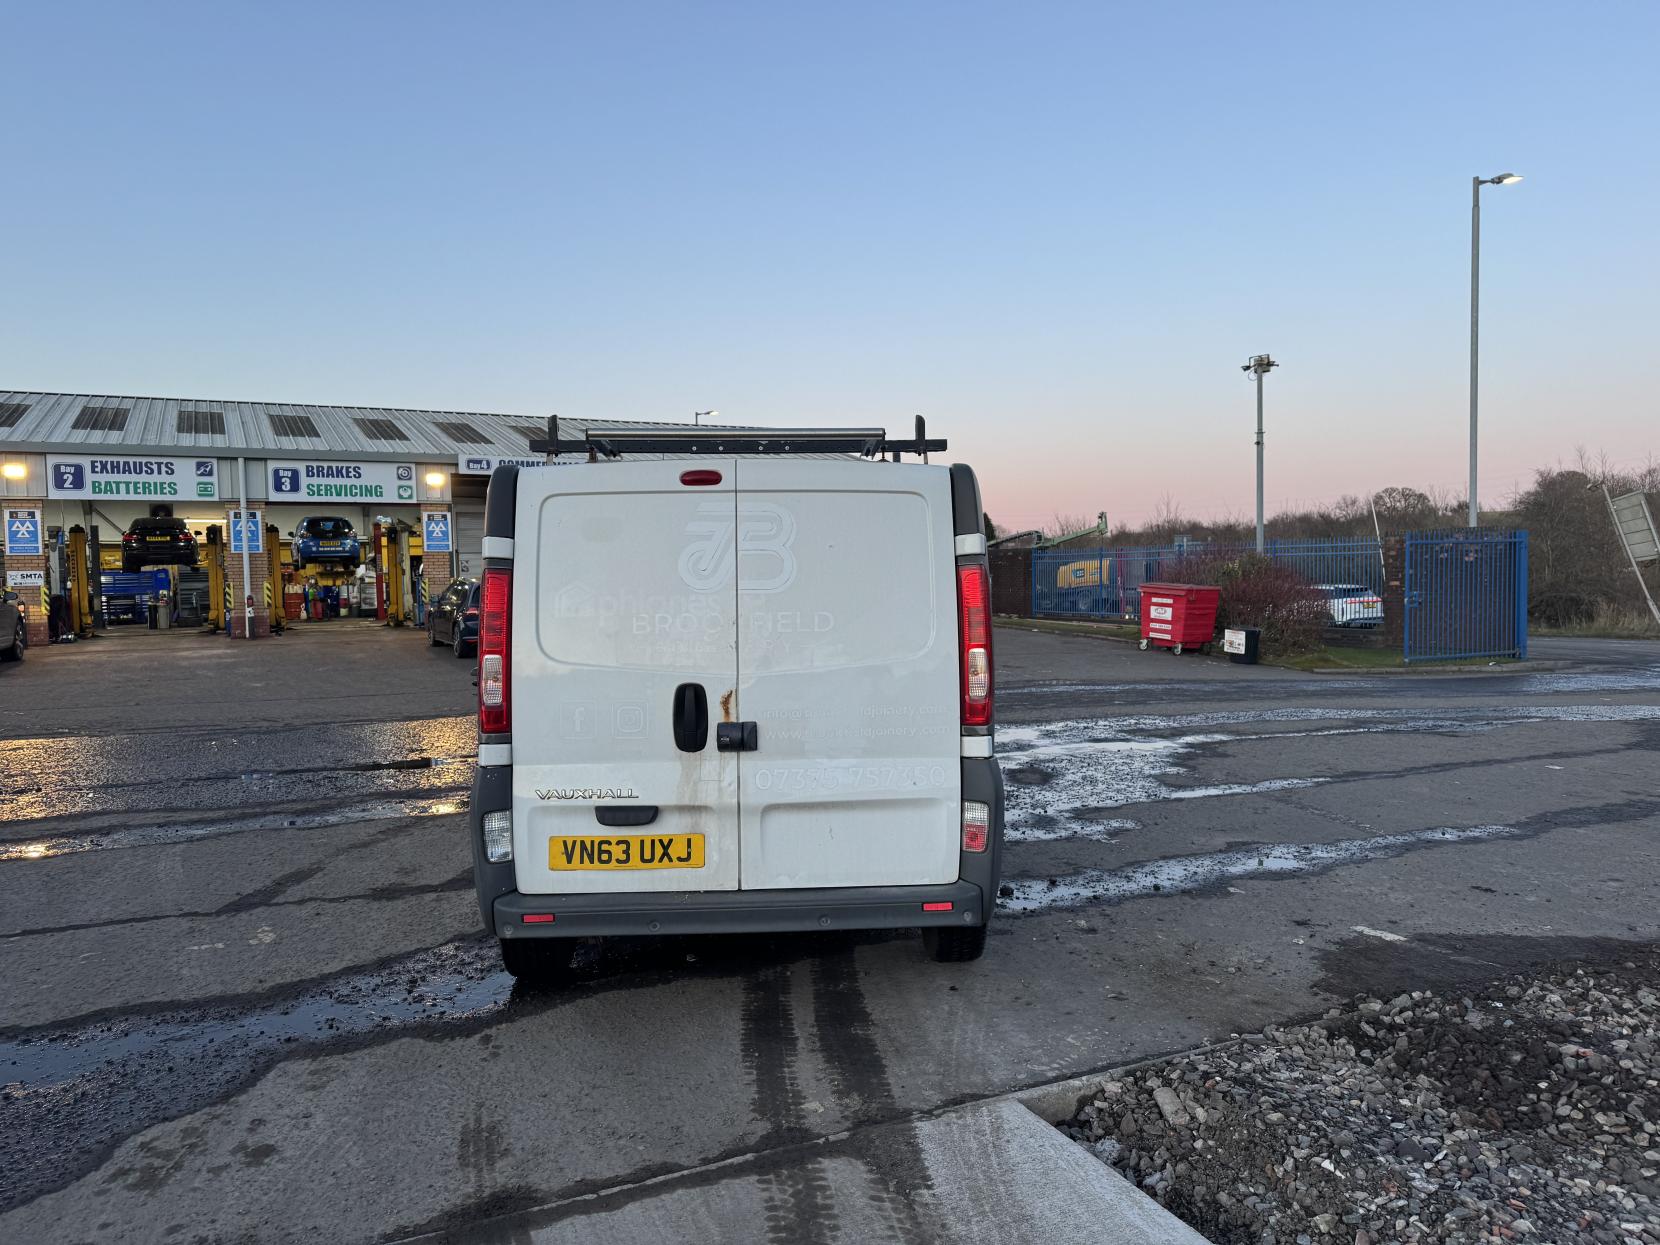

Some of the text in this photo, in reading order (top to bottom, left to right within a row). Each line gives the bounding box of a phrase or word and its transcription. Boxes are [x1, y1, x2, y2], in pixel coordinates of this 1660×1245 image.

[60, 465, 75, 474] Bay
[90, 460, 175, 475] EXHAUSTS
[279, 469, 292, 478] Bay
[305, 465, 362, 479] BRAKES
[63, 474, 73, 488] 2
[91, 480, 177, 495] BATTERIES
[281, 477, 291, 491] 3
[306, 483, 384, 498] SERVICING
[535, 788, 639, 800] VAUXHALL
[562, 838, 692, 865] VN63 UXJ
